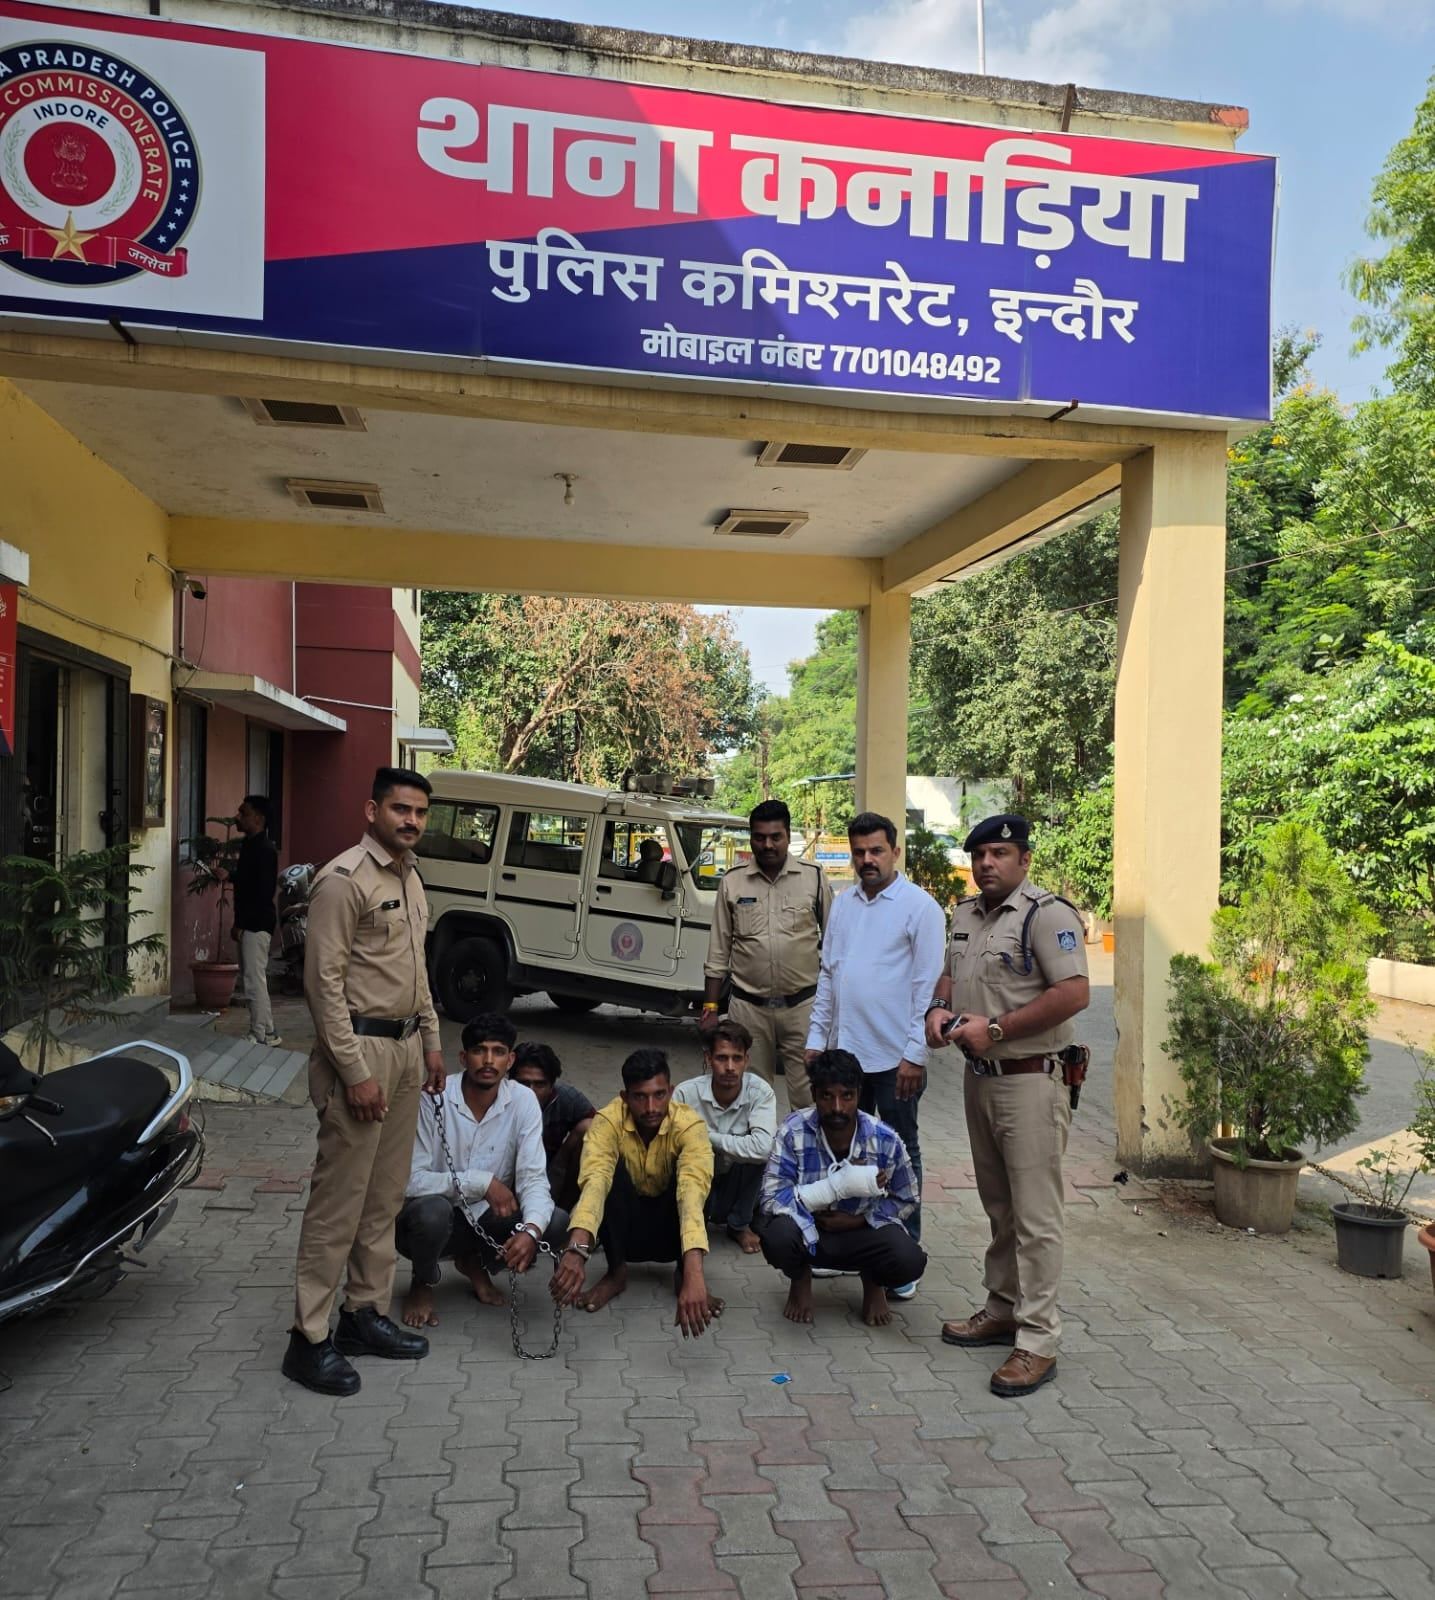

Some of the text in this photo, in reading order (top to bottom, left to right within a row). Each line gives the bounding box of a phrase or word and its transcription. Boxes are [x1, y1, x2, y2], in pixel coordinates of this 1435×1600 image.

[4, 76, 163, 203] COMMISSIONERATE
[18, 49, 192, 170] PRADESH POLICE
[33, 103, 109, 129] INDORE
[416, 97, 1200, 270] थाना कनाड़िया
[128, 247, 173, 272] जनसेवा
[485, 227, 1140, 344] पुलिस कमिश्नरेट, इन्दौर
[640, 323, 1001, 384] मोबाइल नंबर 7701048492
